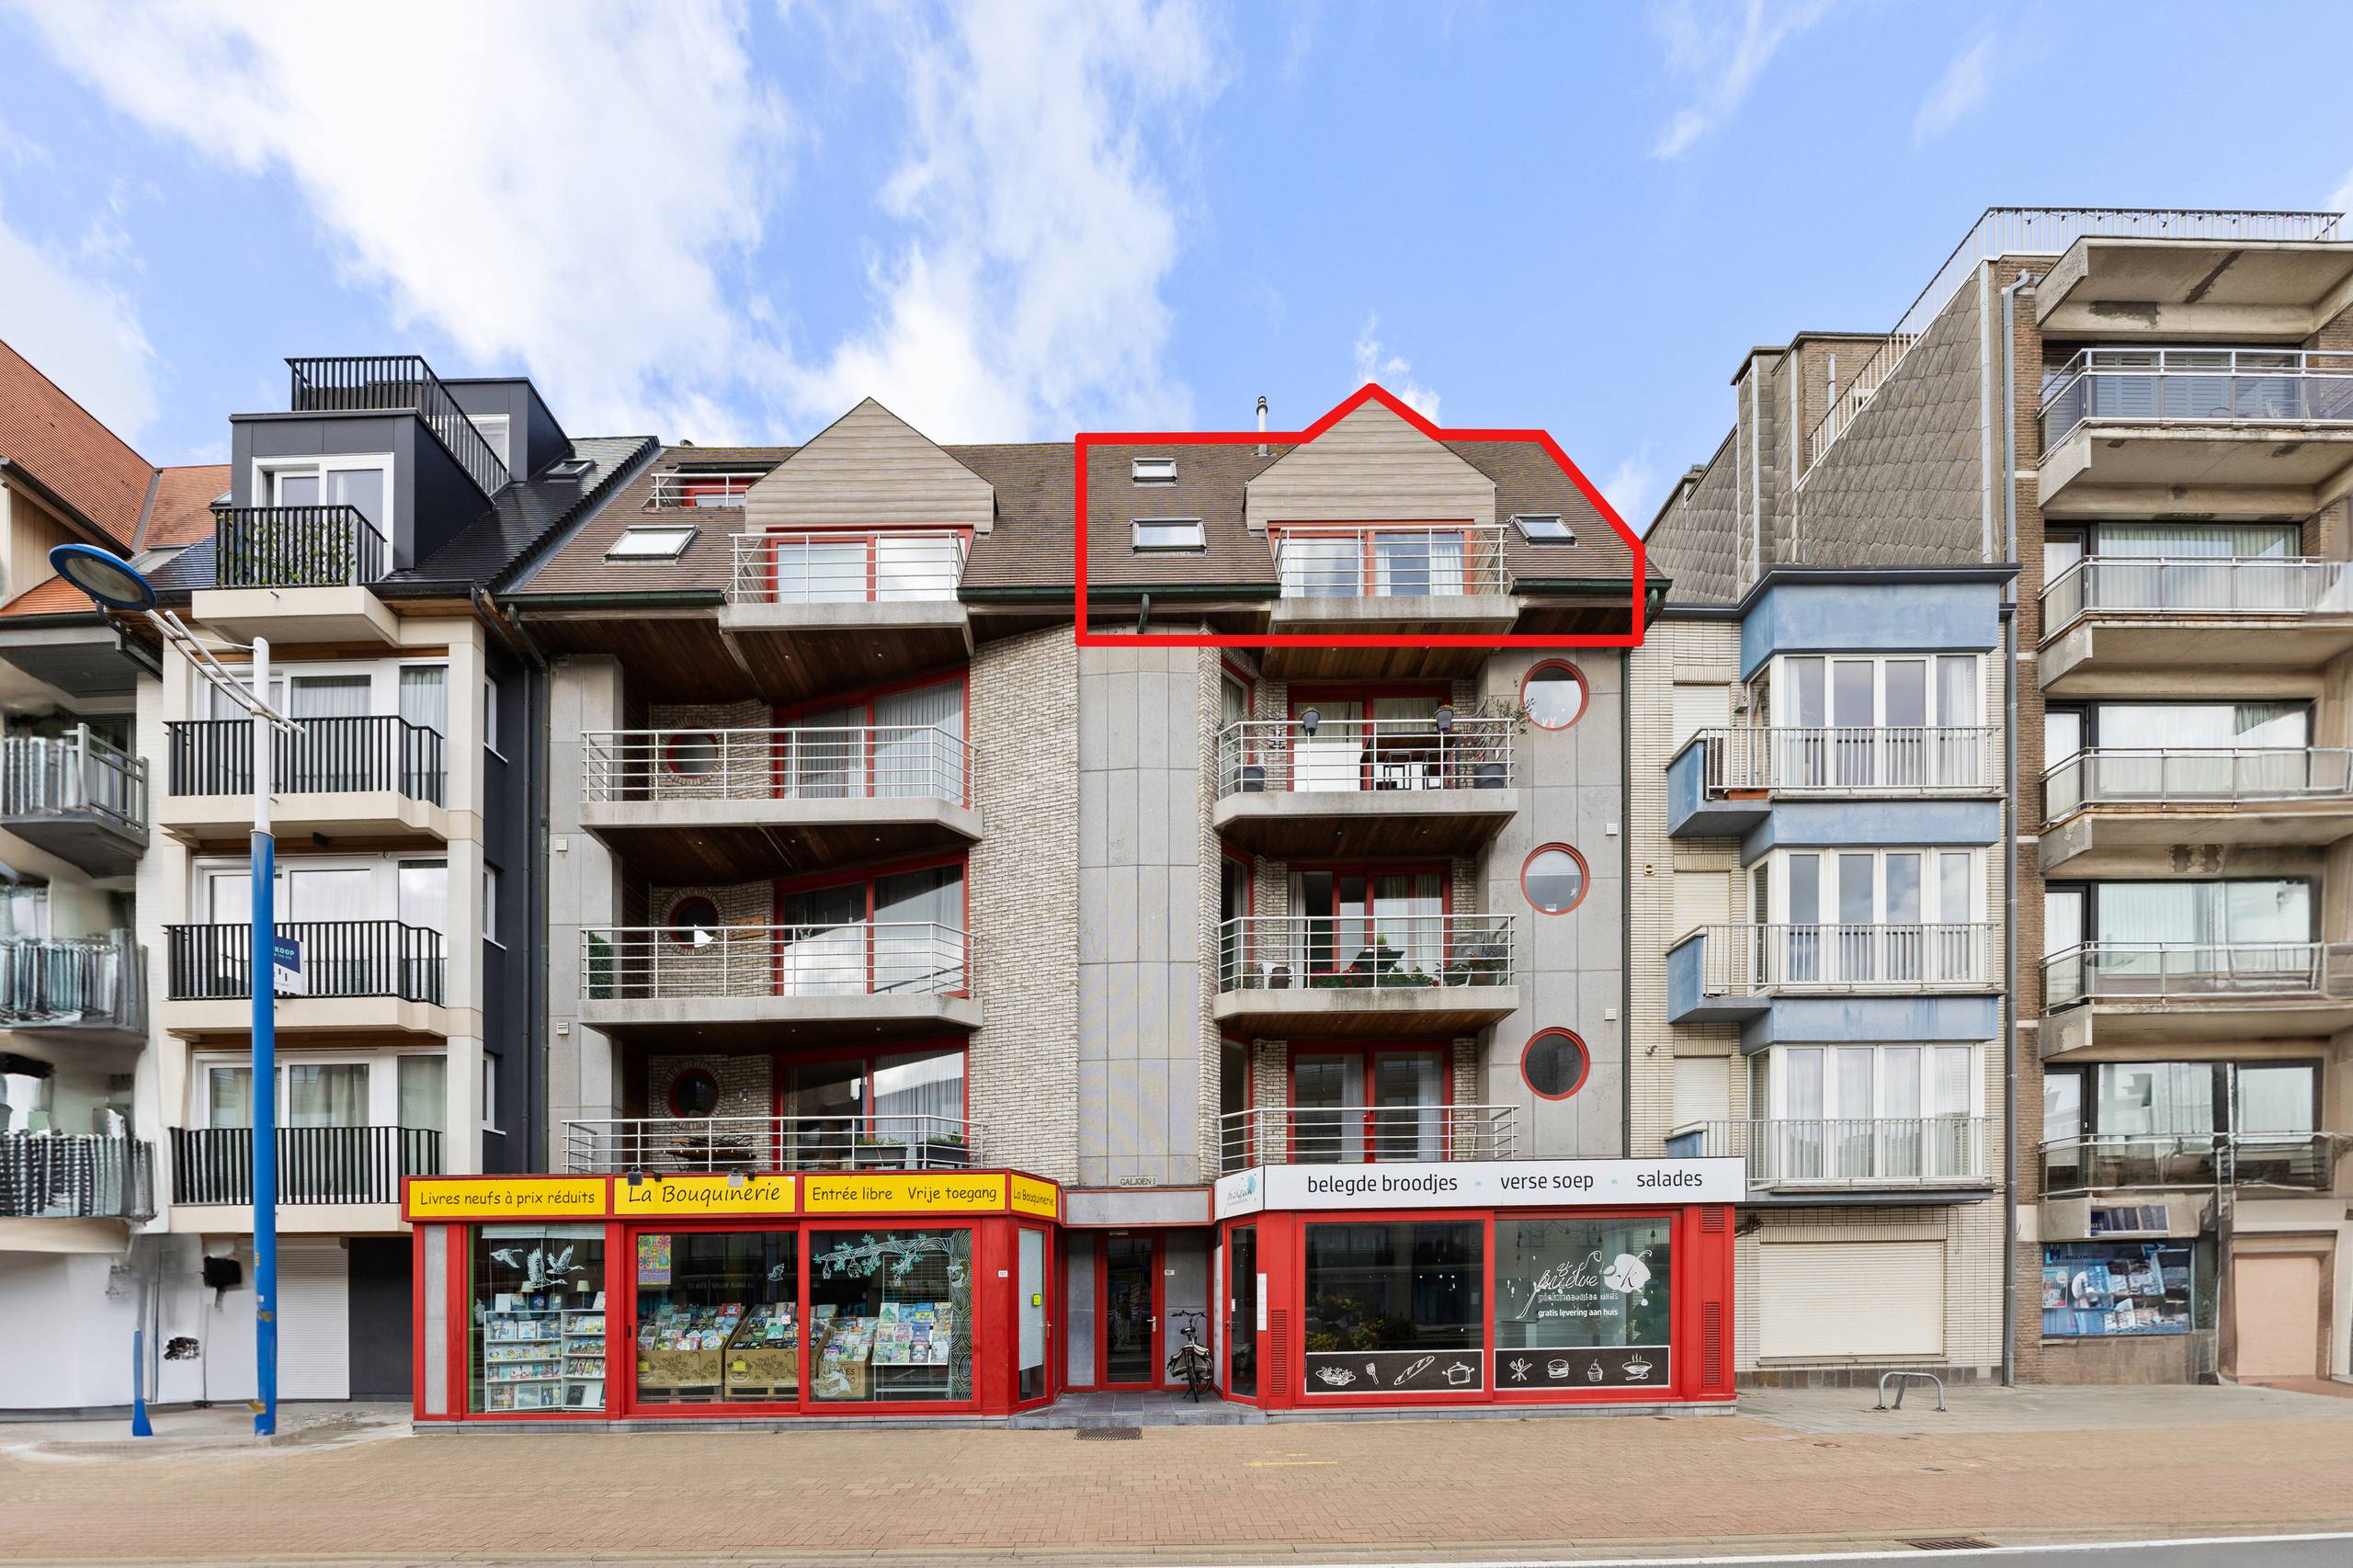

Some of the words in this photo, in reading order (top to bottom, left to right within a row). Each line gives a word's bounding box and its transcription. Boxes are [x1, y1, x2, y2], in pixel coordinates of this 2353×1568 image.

[274, 946, 295, 956] KOOP
[1120, 1176, 1152, 1186] GALJOEN
[1308, 1175, 1377, 1196] belegde
[1382, 1174, 1458, 1195] broodjes
[1500, 1176, 1548, 1189] verse
[1552, 1175, 1594, 1191] soep
[1637, 1170, 1703, 1187] salades
[420, 1192, 460, 1205] Livres
[464, 1191, 501, 1205] neufs
[505, 1190, 513, 1204] à
[517, 1191, 543, 1208] prix
[547, 1189, 595, 1204] réduits
[629, 1187, 652, 1202] La
[662, 1182, 780, 1207] Bouquinerie
[813, 1186, 858, 1200] Entrée
[862, 1187, 893, 1199] libre
[907, 1187, 941, 1203] Vrije
[945, 1187, 997, 1202] toegang
[1013, 1187, 1021, 1199] La
[1022, 1188, 1054, 1207] Bouquinerie
[1538, 1309, 1559, 1318] gratis
[1559, 1308, 1588, 1318] levering
[1603, 1308, 1619, 1316] huis
